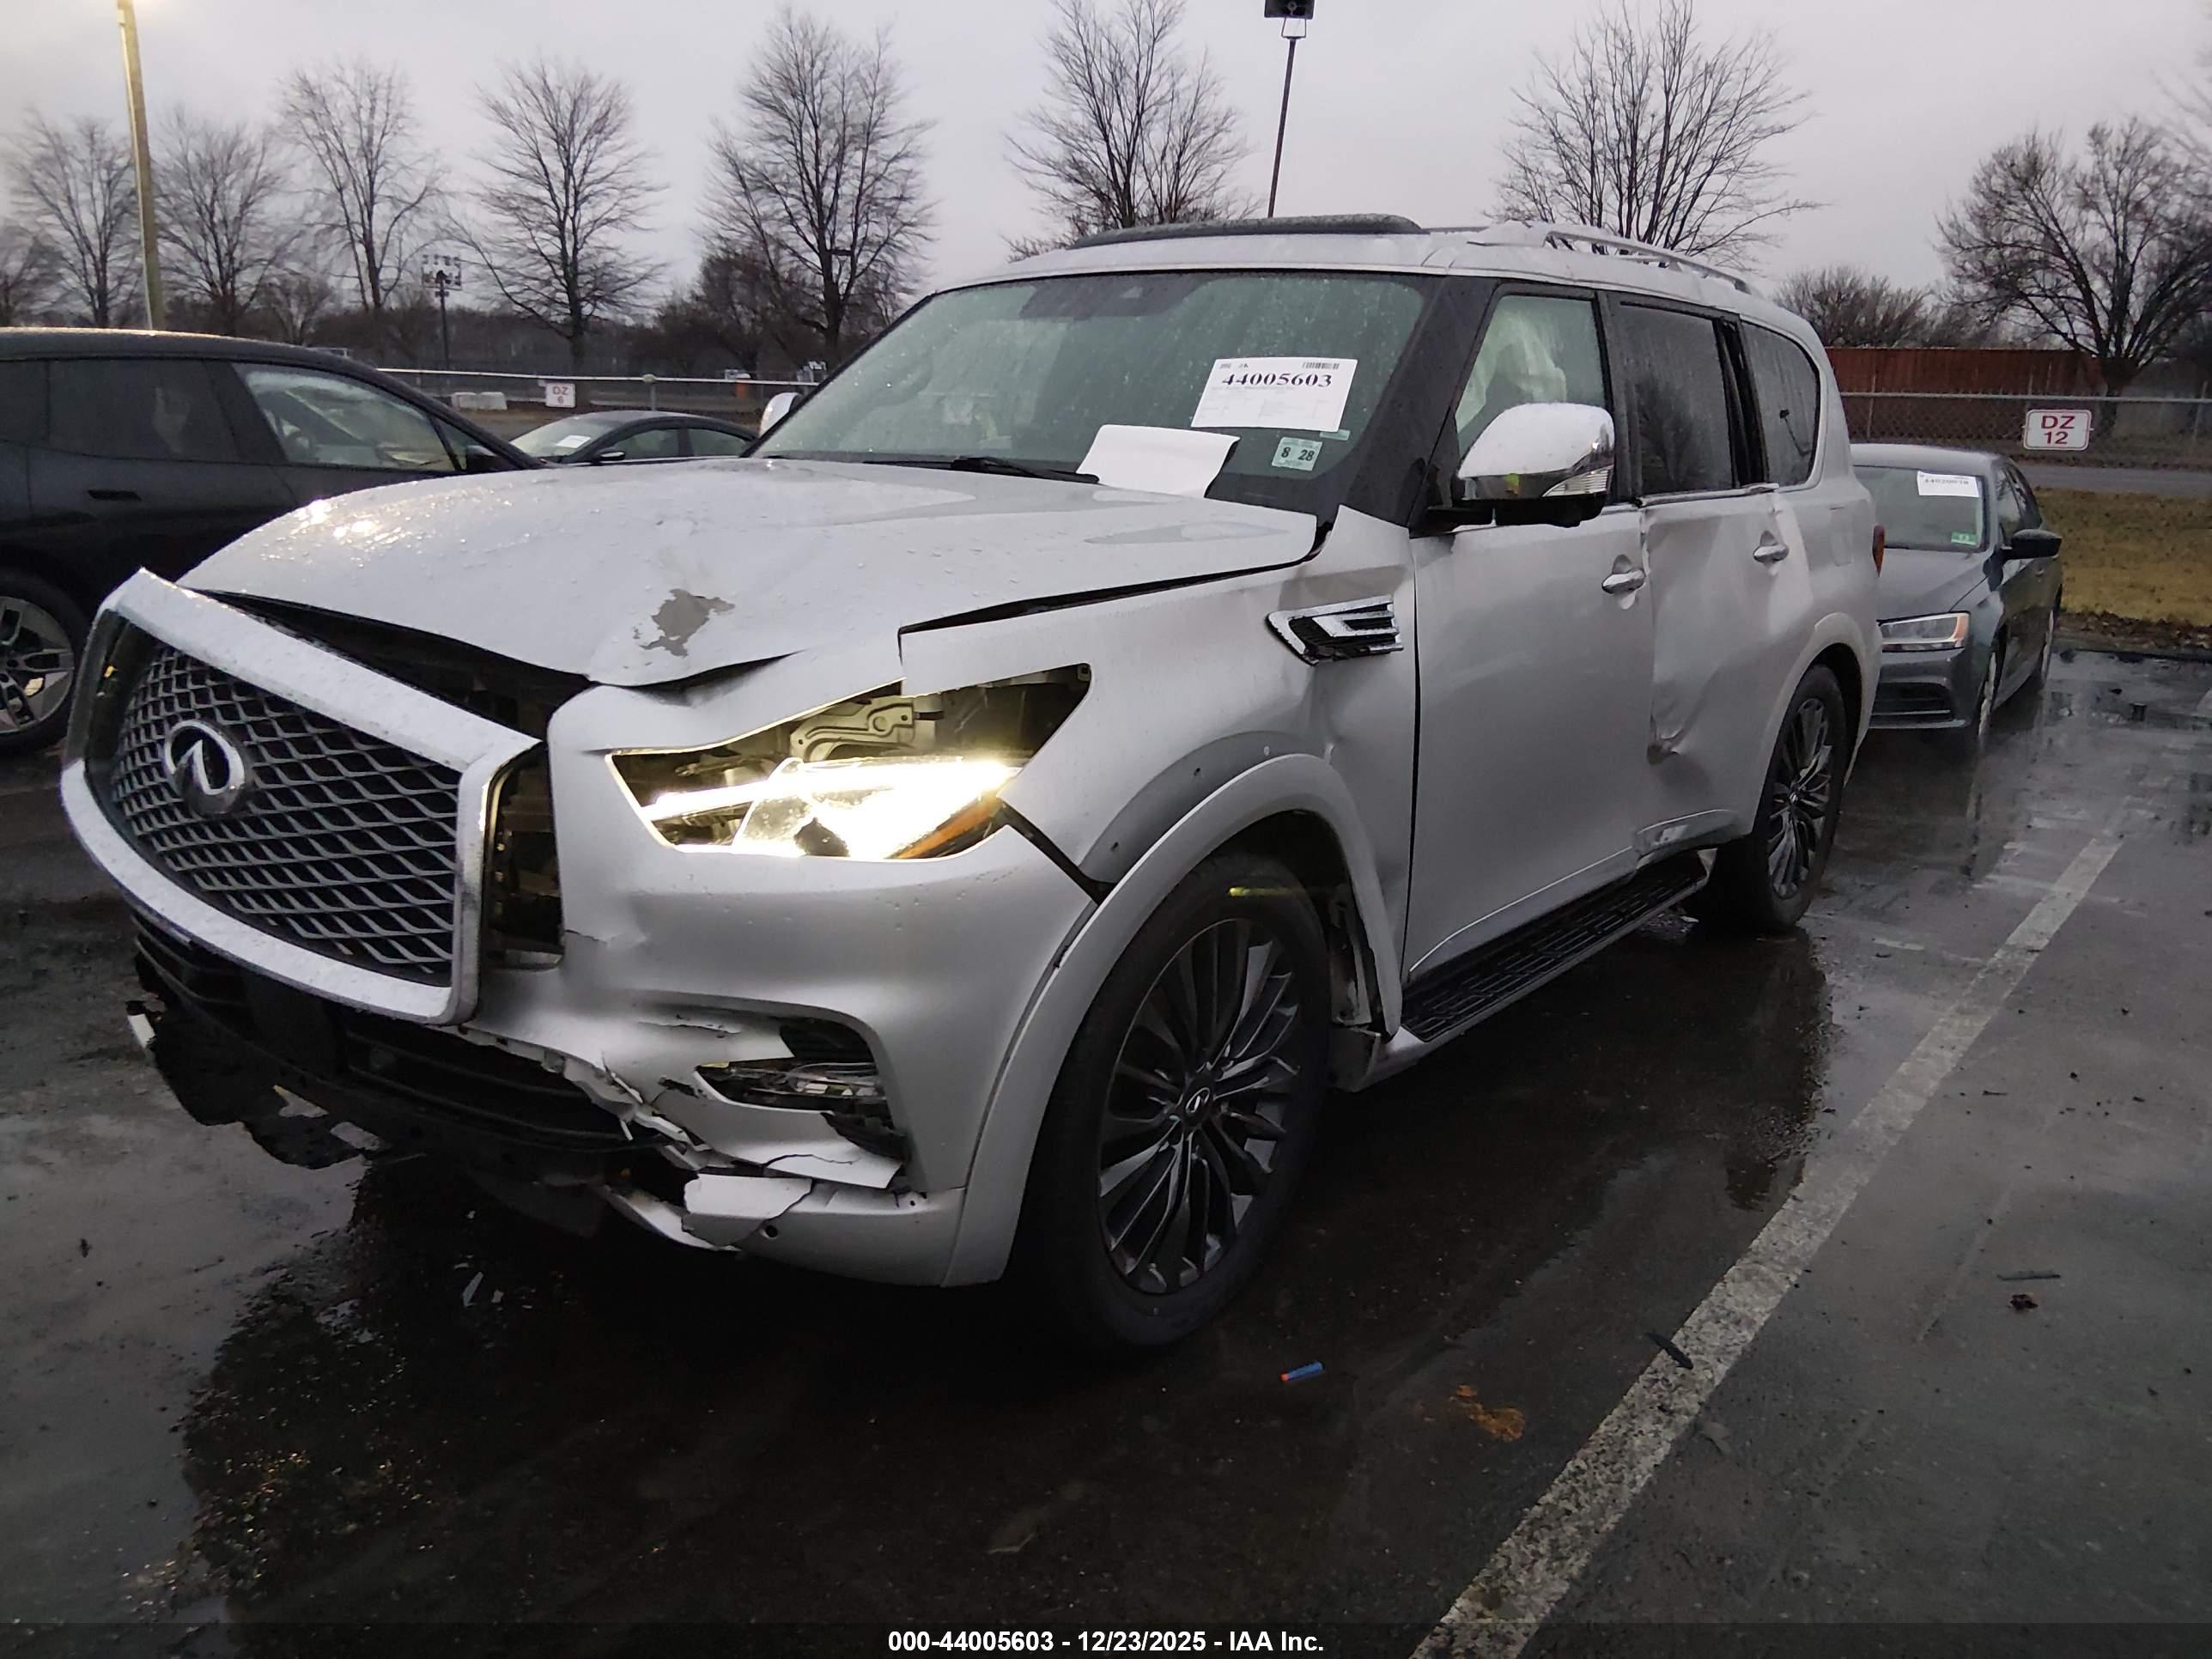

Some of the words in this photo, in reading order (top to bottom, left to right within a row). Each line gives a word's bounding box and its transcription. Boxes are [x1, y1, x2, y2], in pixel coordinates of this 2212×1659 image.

[1222, 372, 1332, 388] 44005603
[552, 386, 569, 395] DZ
[557, 396, 564, 404] 6
[2041, 416, 2075, 429] DZ
[2044, 431, 2069, 444] 12
[1281, 447, 1291, 458] 8
[1297, 449, 1315, 461] 28
